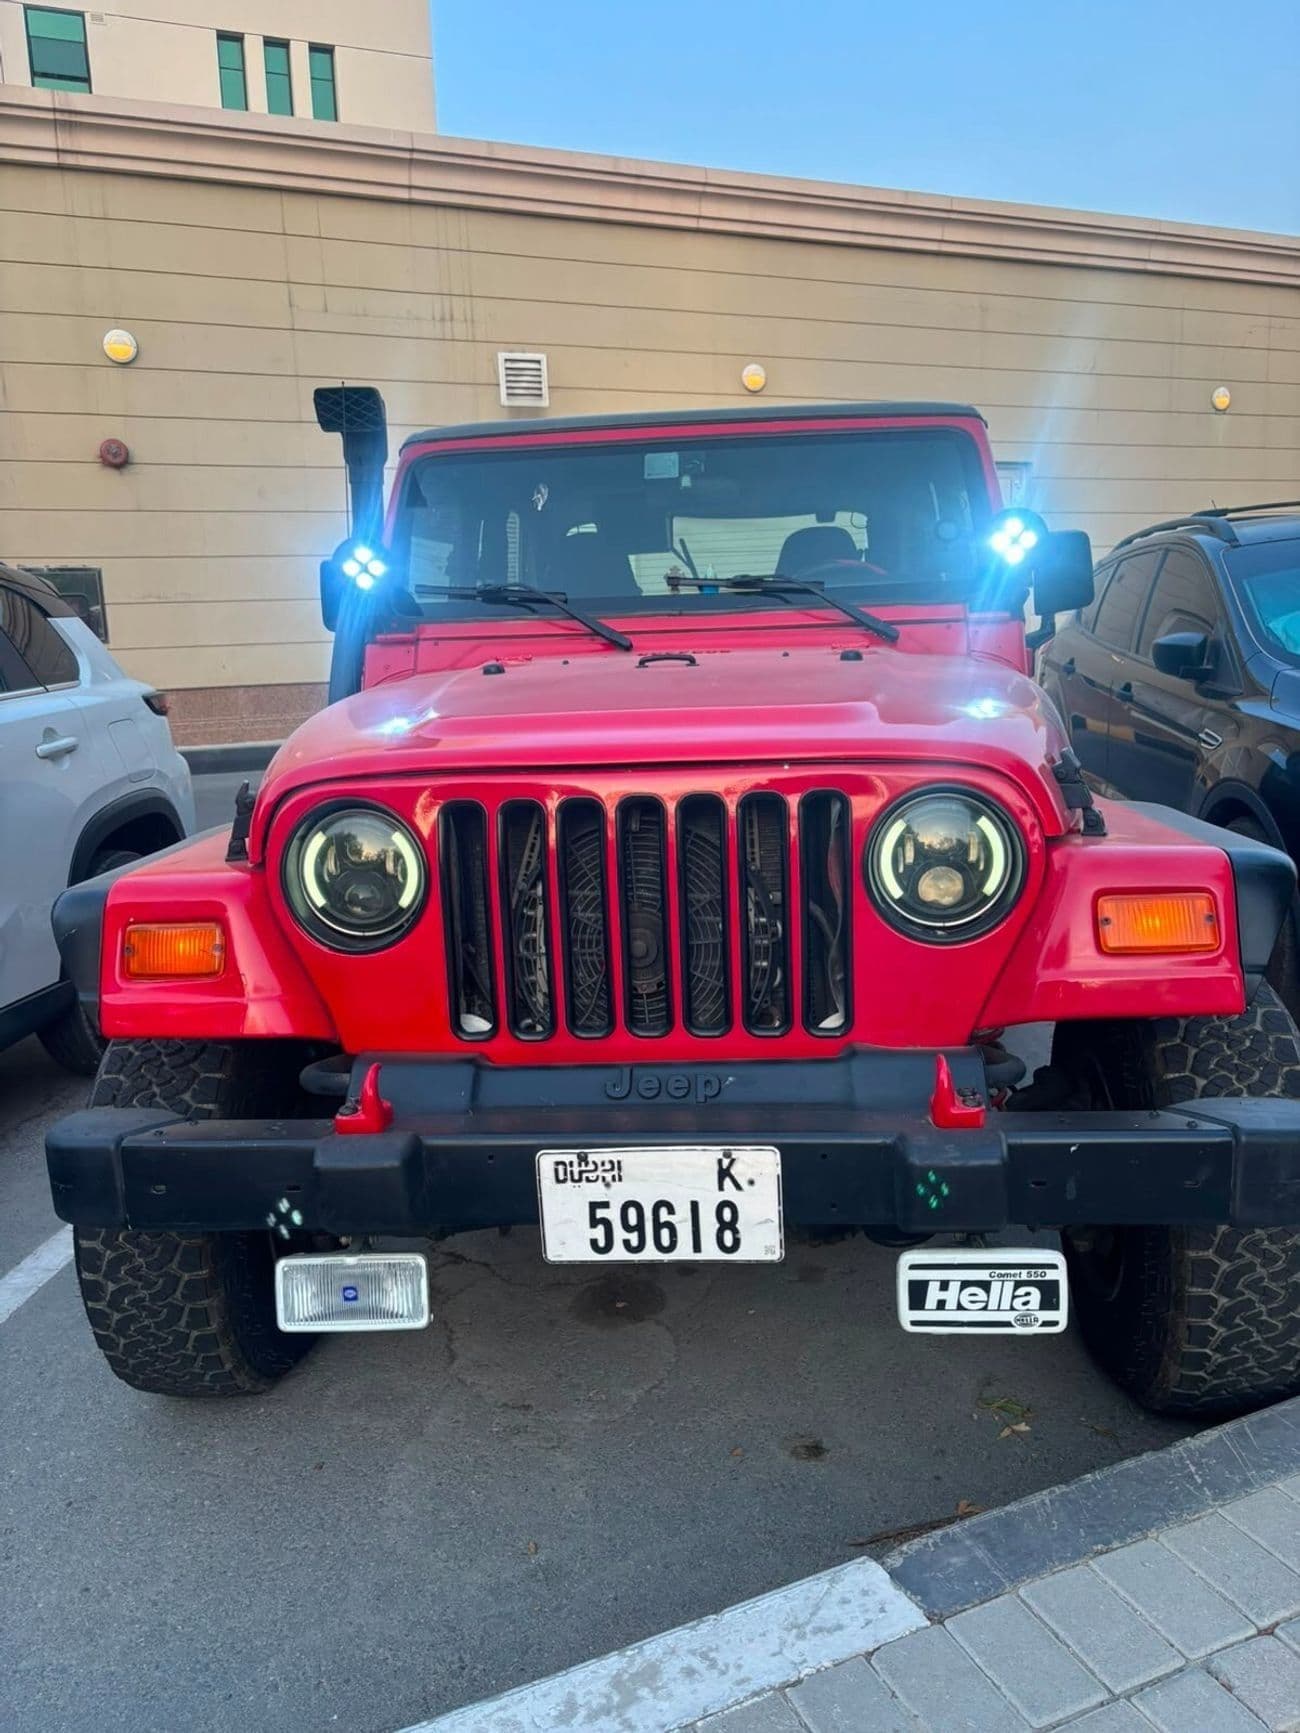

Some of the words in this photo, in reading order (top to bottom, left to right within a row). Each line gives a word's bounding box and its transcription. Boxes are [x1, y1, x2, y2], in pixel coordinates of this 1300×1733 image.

[604, 1065, 721, 1104] Jeep
[553, 1160, 623, 1184] DUBAI
[717, 1158, 743, 1192] K
[588, 1200, 742, 1254] 59618
[989, 1271, 1022, 1279] Comet
[1026, 1271, 1047, 1279] 550
[924, 1280, 1041, 1311] Hella
